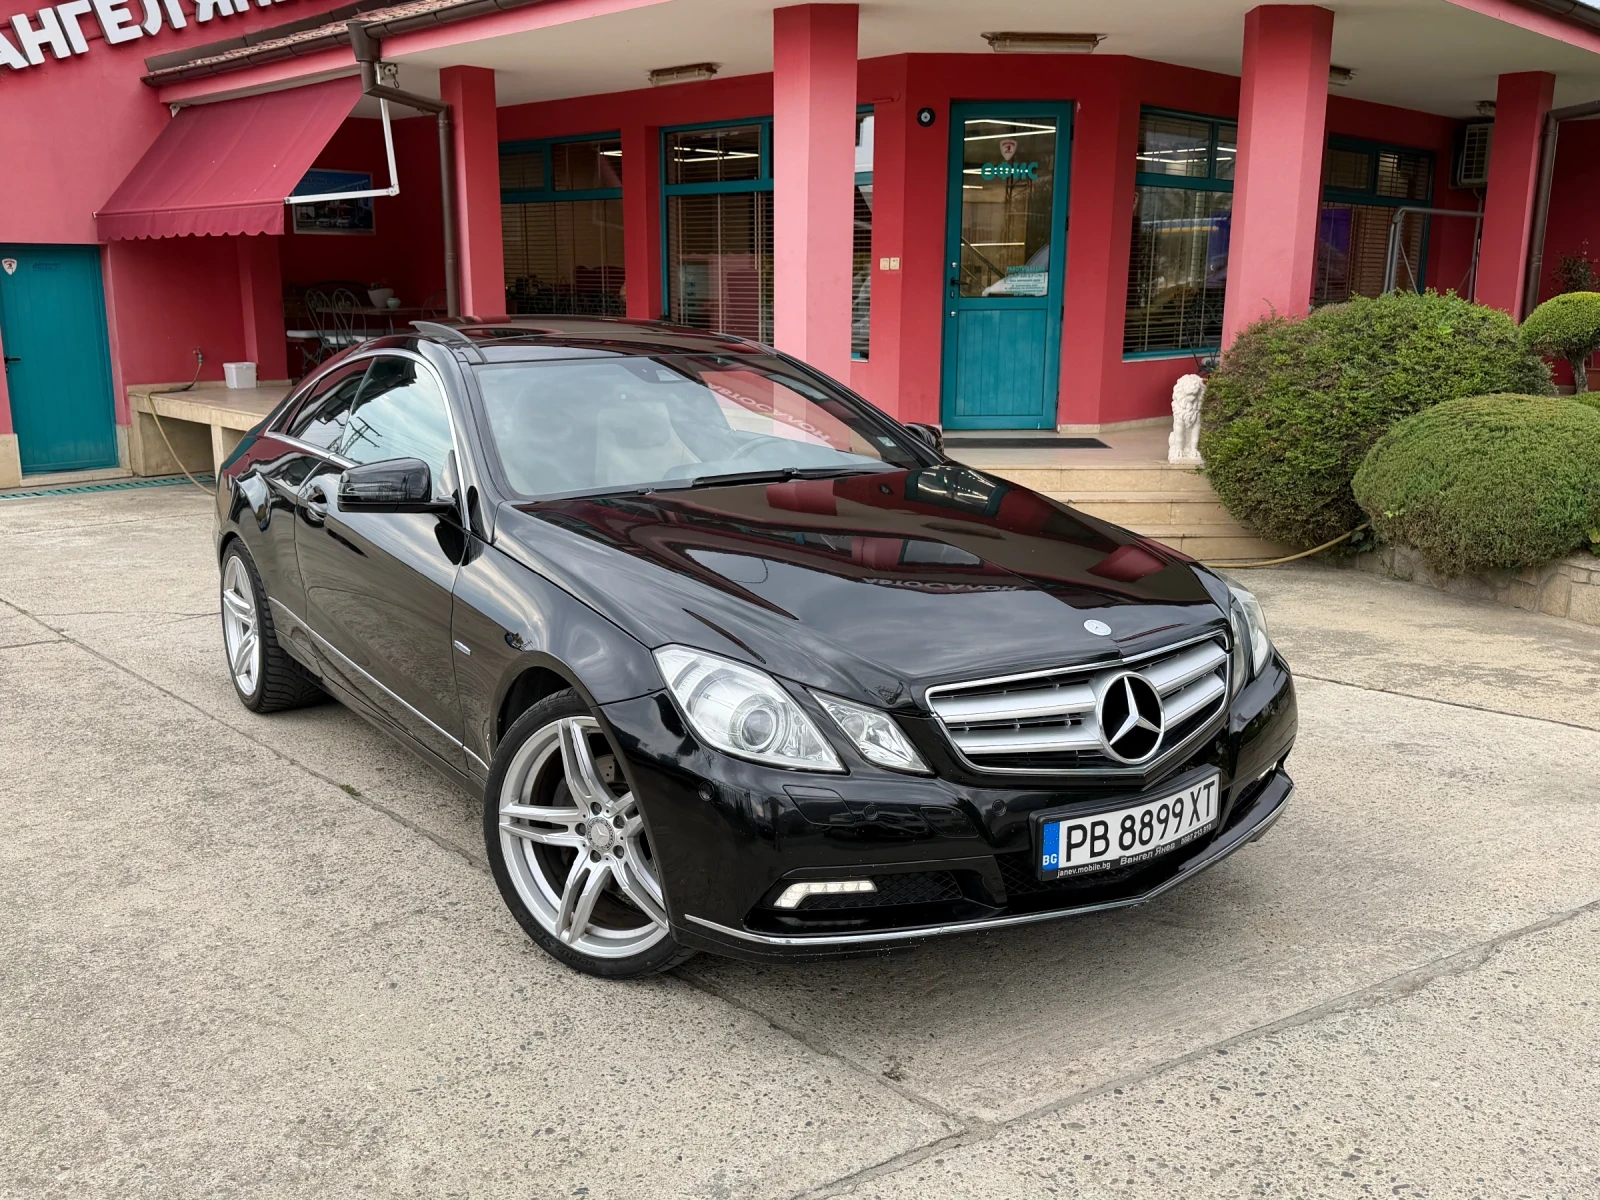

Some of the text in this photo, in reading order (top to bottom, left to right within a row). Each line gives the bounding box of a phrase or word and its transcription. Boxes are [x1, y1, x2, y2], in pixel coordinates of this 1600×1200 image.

[981, 161, 1039, 181] ОФИС
[1065, 780, 1216, 863] PB 8899 XT
[1042, 853, 1058, 866] BG
[1120, 851, 1153, 866] Вангел
[1154, 842, 1176, 856] Янев
[1057, 862, 1111, 878] janev.mobile.bg
